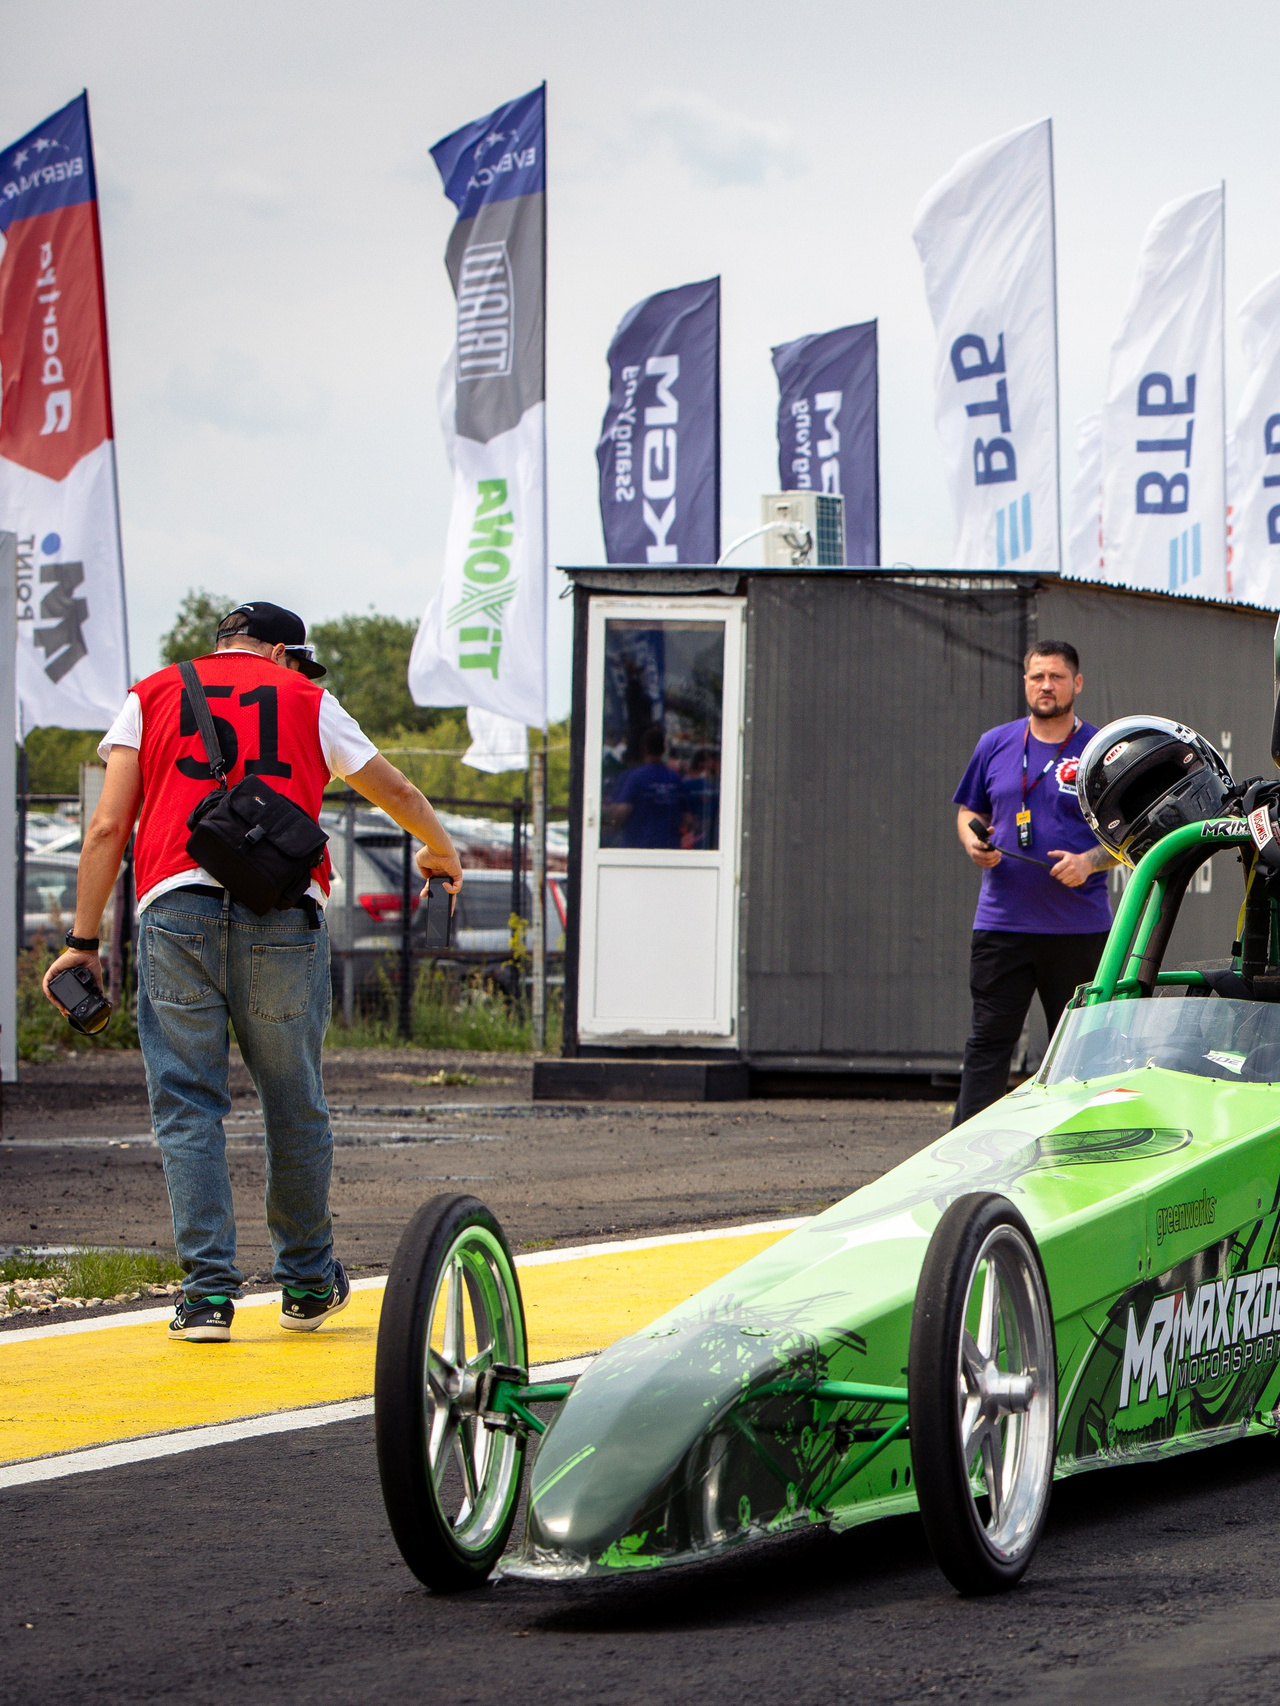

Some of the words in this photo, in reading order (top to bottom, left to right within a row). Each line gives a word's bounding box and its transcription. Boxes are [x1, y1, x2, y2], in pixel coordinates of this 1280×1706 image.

[175, 684, 293, 781] 51
[1253, 812, 1268, 841] SIMPSON
[1156, 1188, 1217, 1246] greenworks
[206, 1318, 227, 1326] ARTENGO
